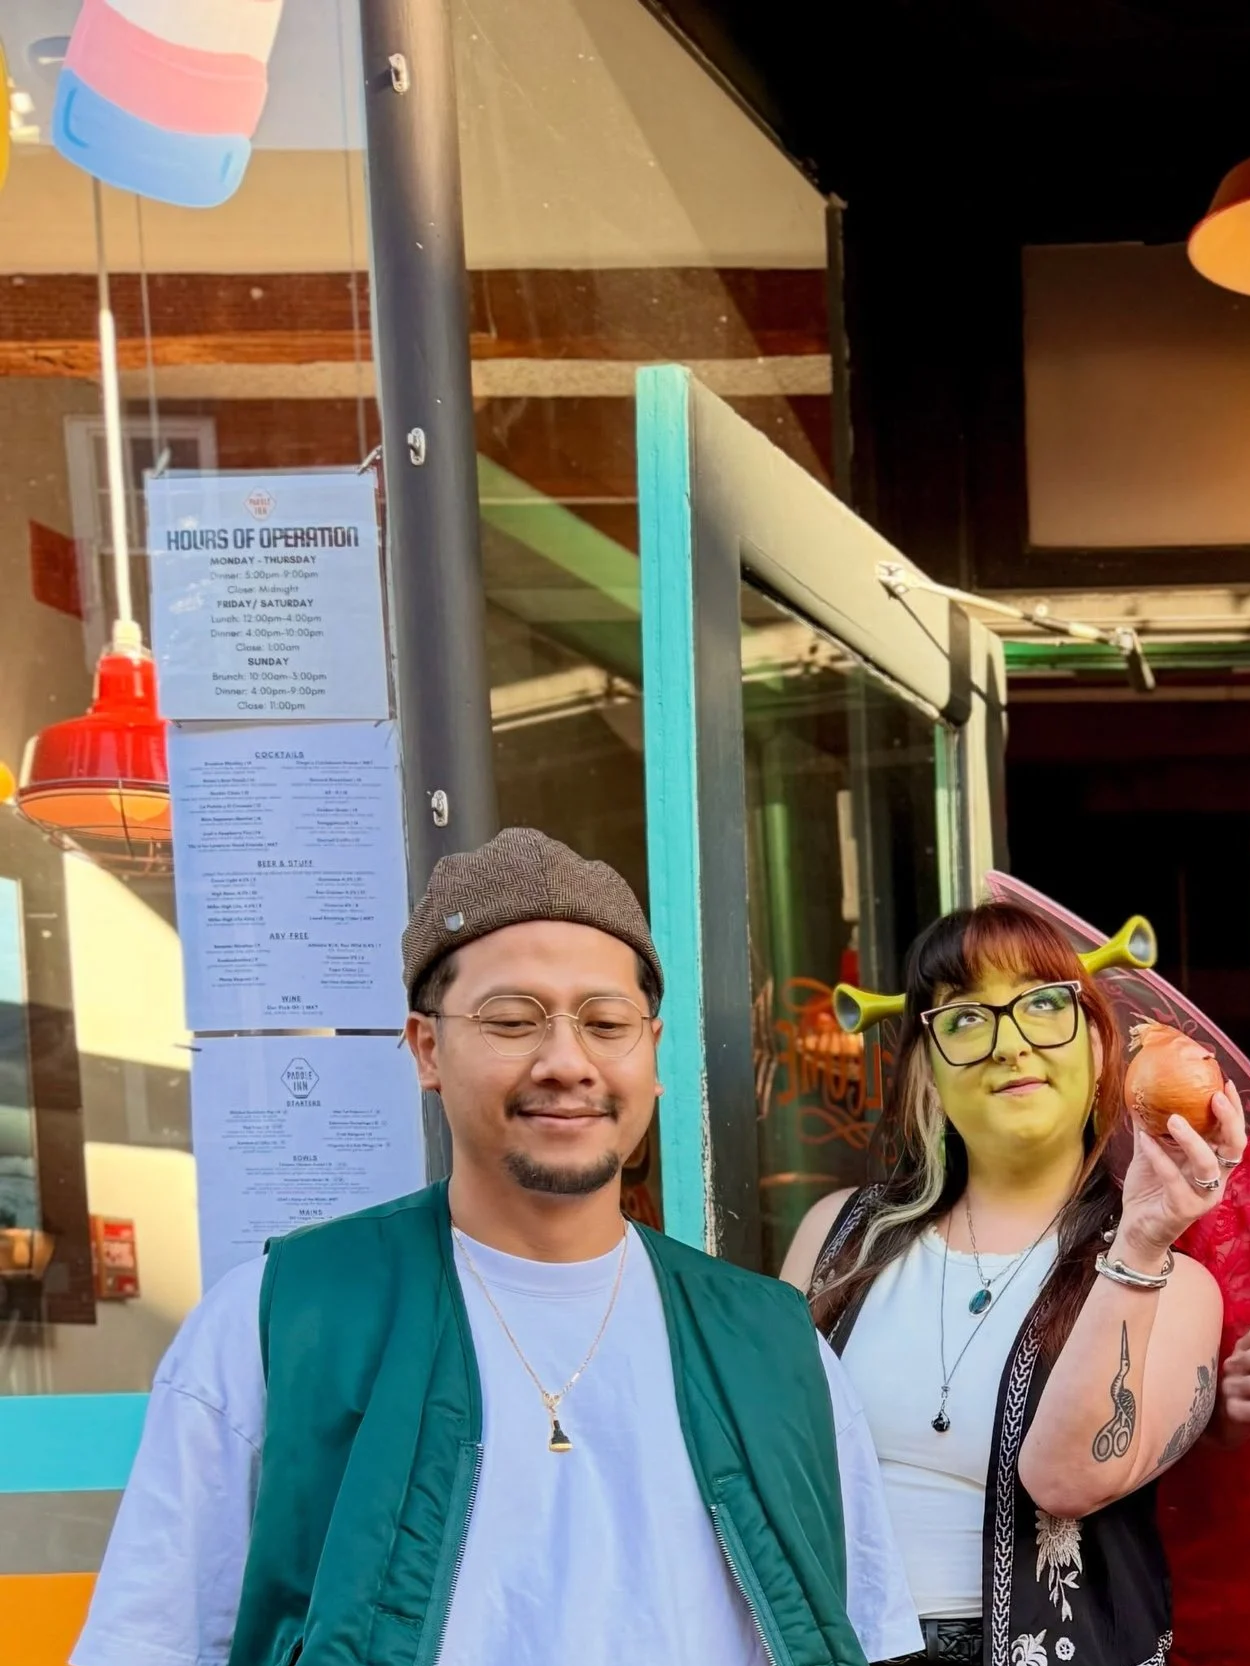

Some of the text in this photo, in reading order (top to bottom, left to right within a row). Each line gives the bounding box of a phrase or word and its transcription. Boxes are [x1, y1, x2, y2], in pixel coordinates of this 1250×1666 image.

[167, 526, 358, 551] HOURS OF OPERATION
[210, 556, 254, 565] MONDAY
[264, 556, 317, 565] THURSDAY
[259, 585, 299, 595] Midnight
[217, 599, 313, 609] FRIDAY/ SATURDAY
[247, 658, 290, 667] SUNDAY
[254, 751, 305, 760] COCKTAILS
[256, 860, 314, 868] BEER & STUFF
[268, 932, 309, 940] ABV FREE
[280, 995, 302, 1003] WINE
[292, 1154, 318, 1162] BOWLS
[298, 1208, 323, 1216] MAINS
